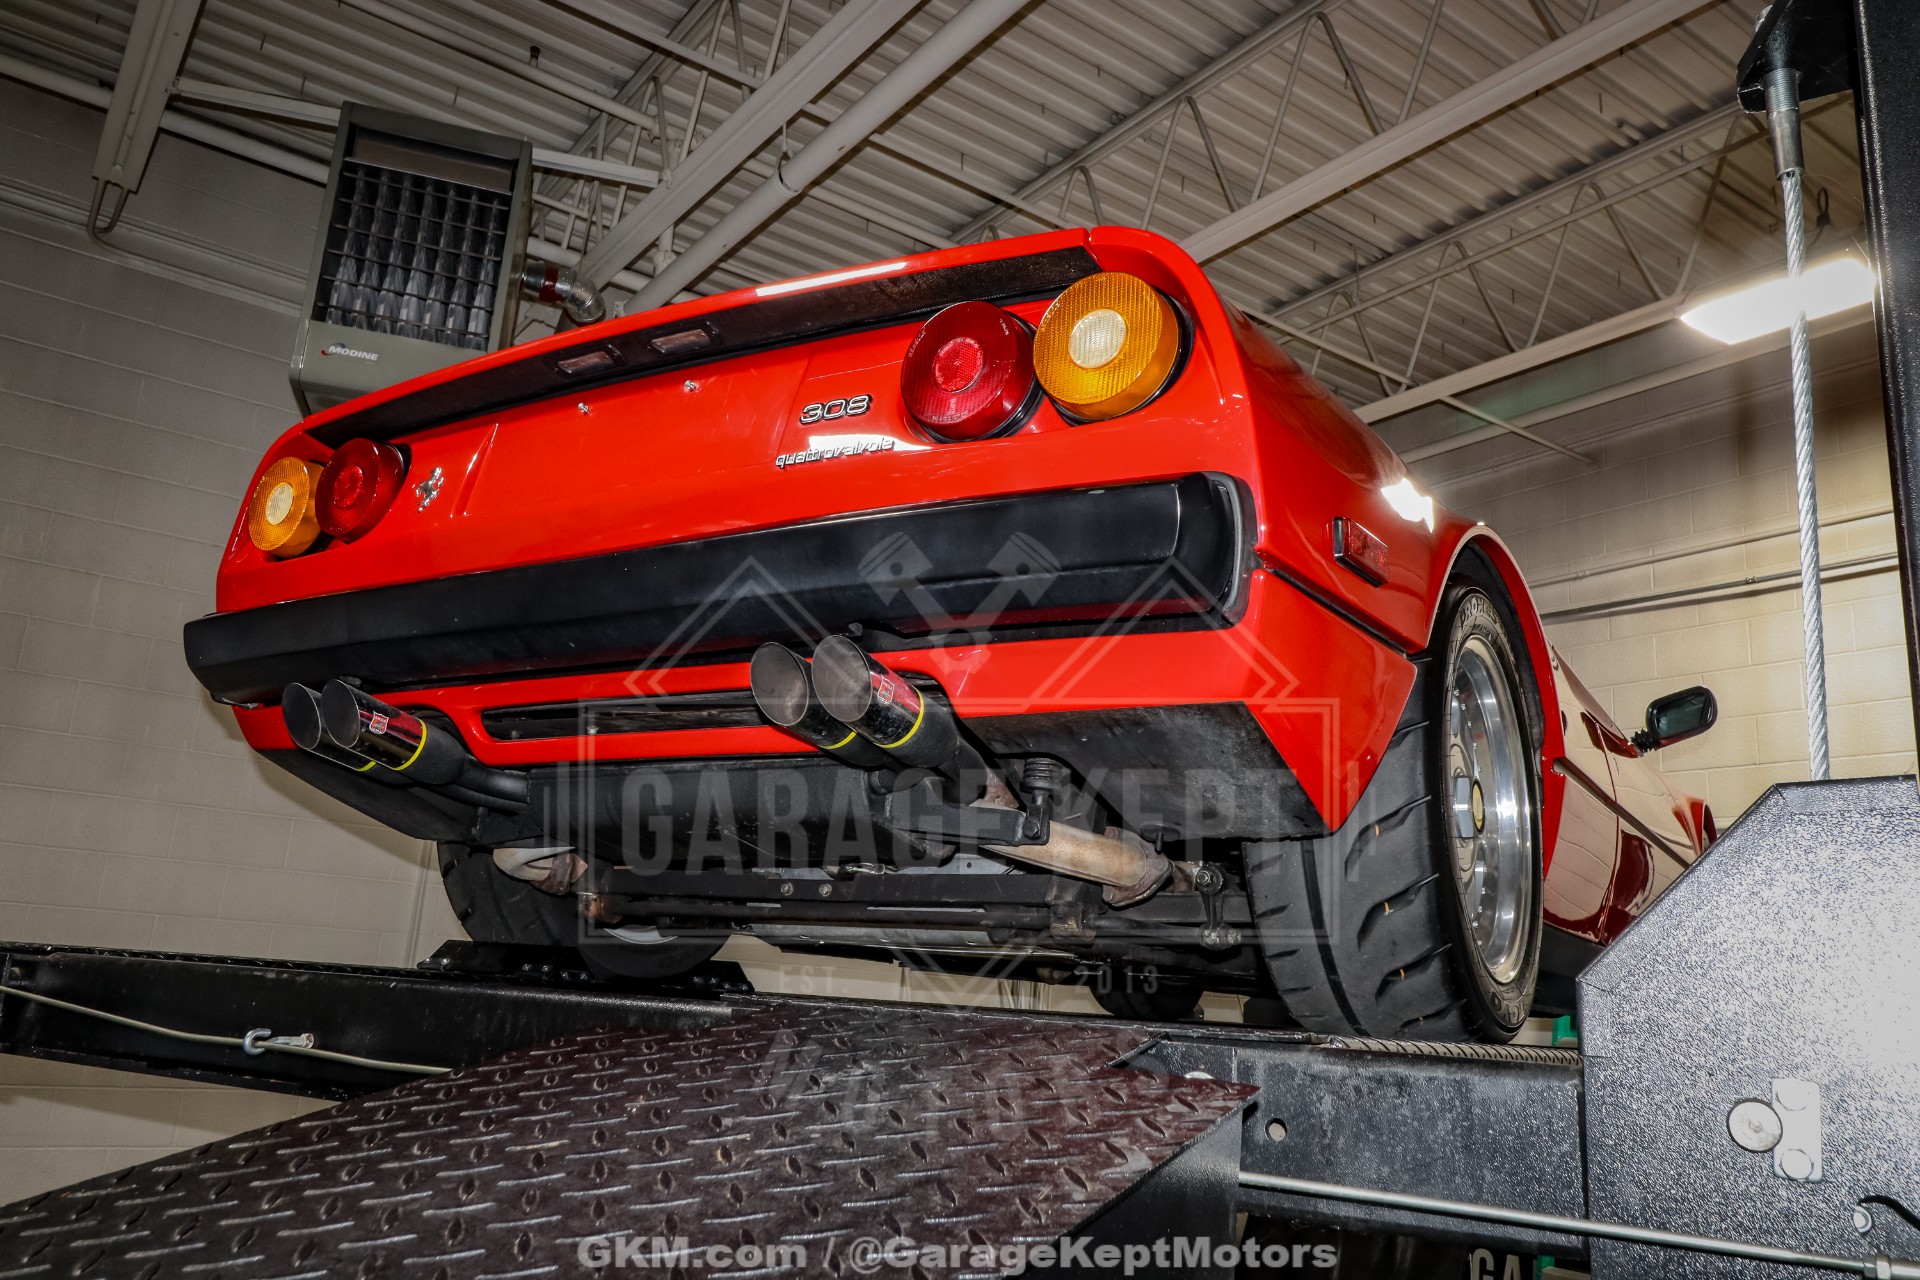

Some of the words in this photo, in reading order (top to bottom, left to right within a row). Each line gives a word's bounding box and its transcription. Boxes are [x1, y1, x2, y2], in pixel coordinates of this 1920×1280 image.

[328, 345, 379, 361] MODINE
[799, 394, 873, 425] 308
[775, 437, 896, 469] quattrovalvole
